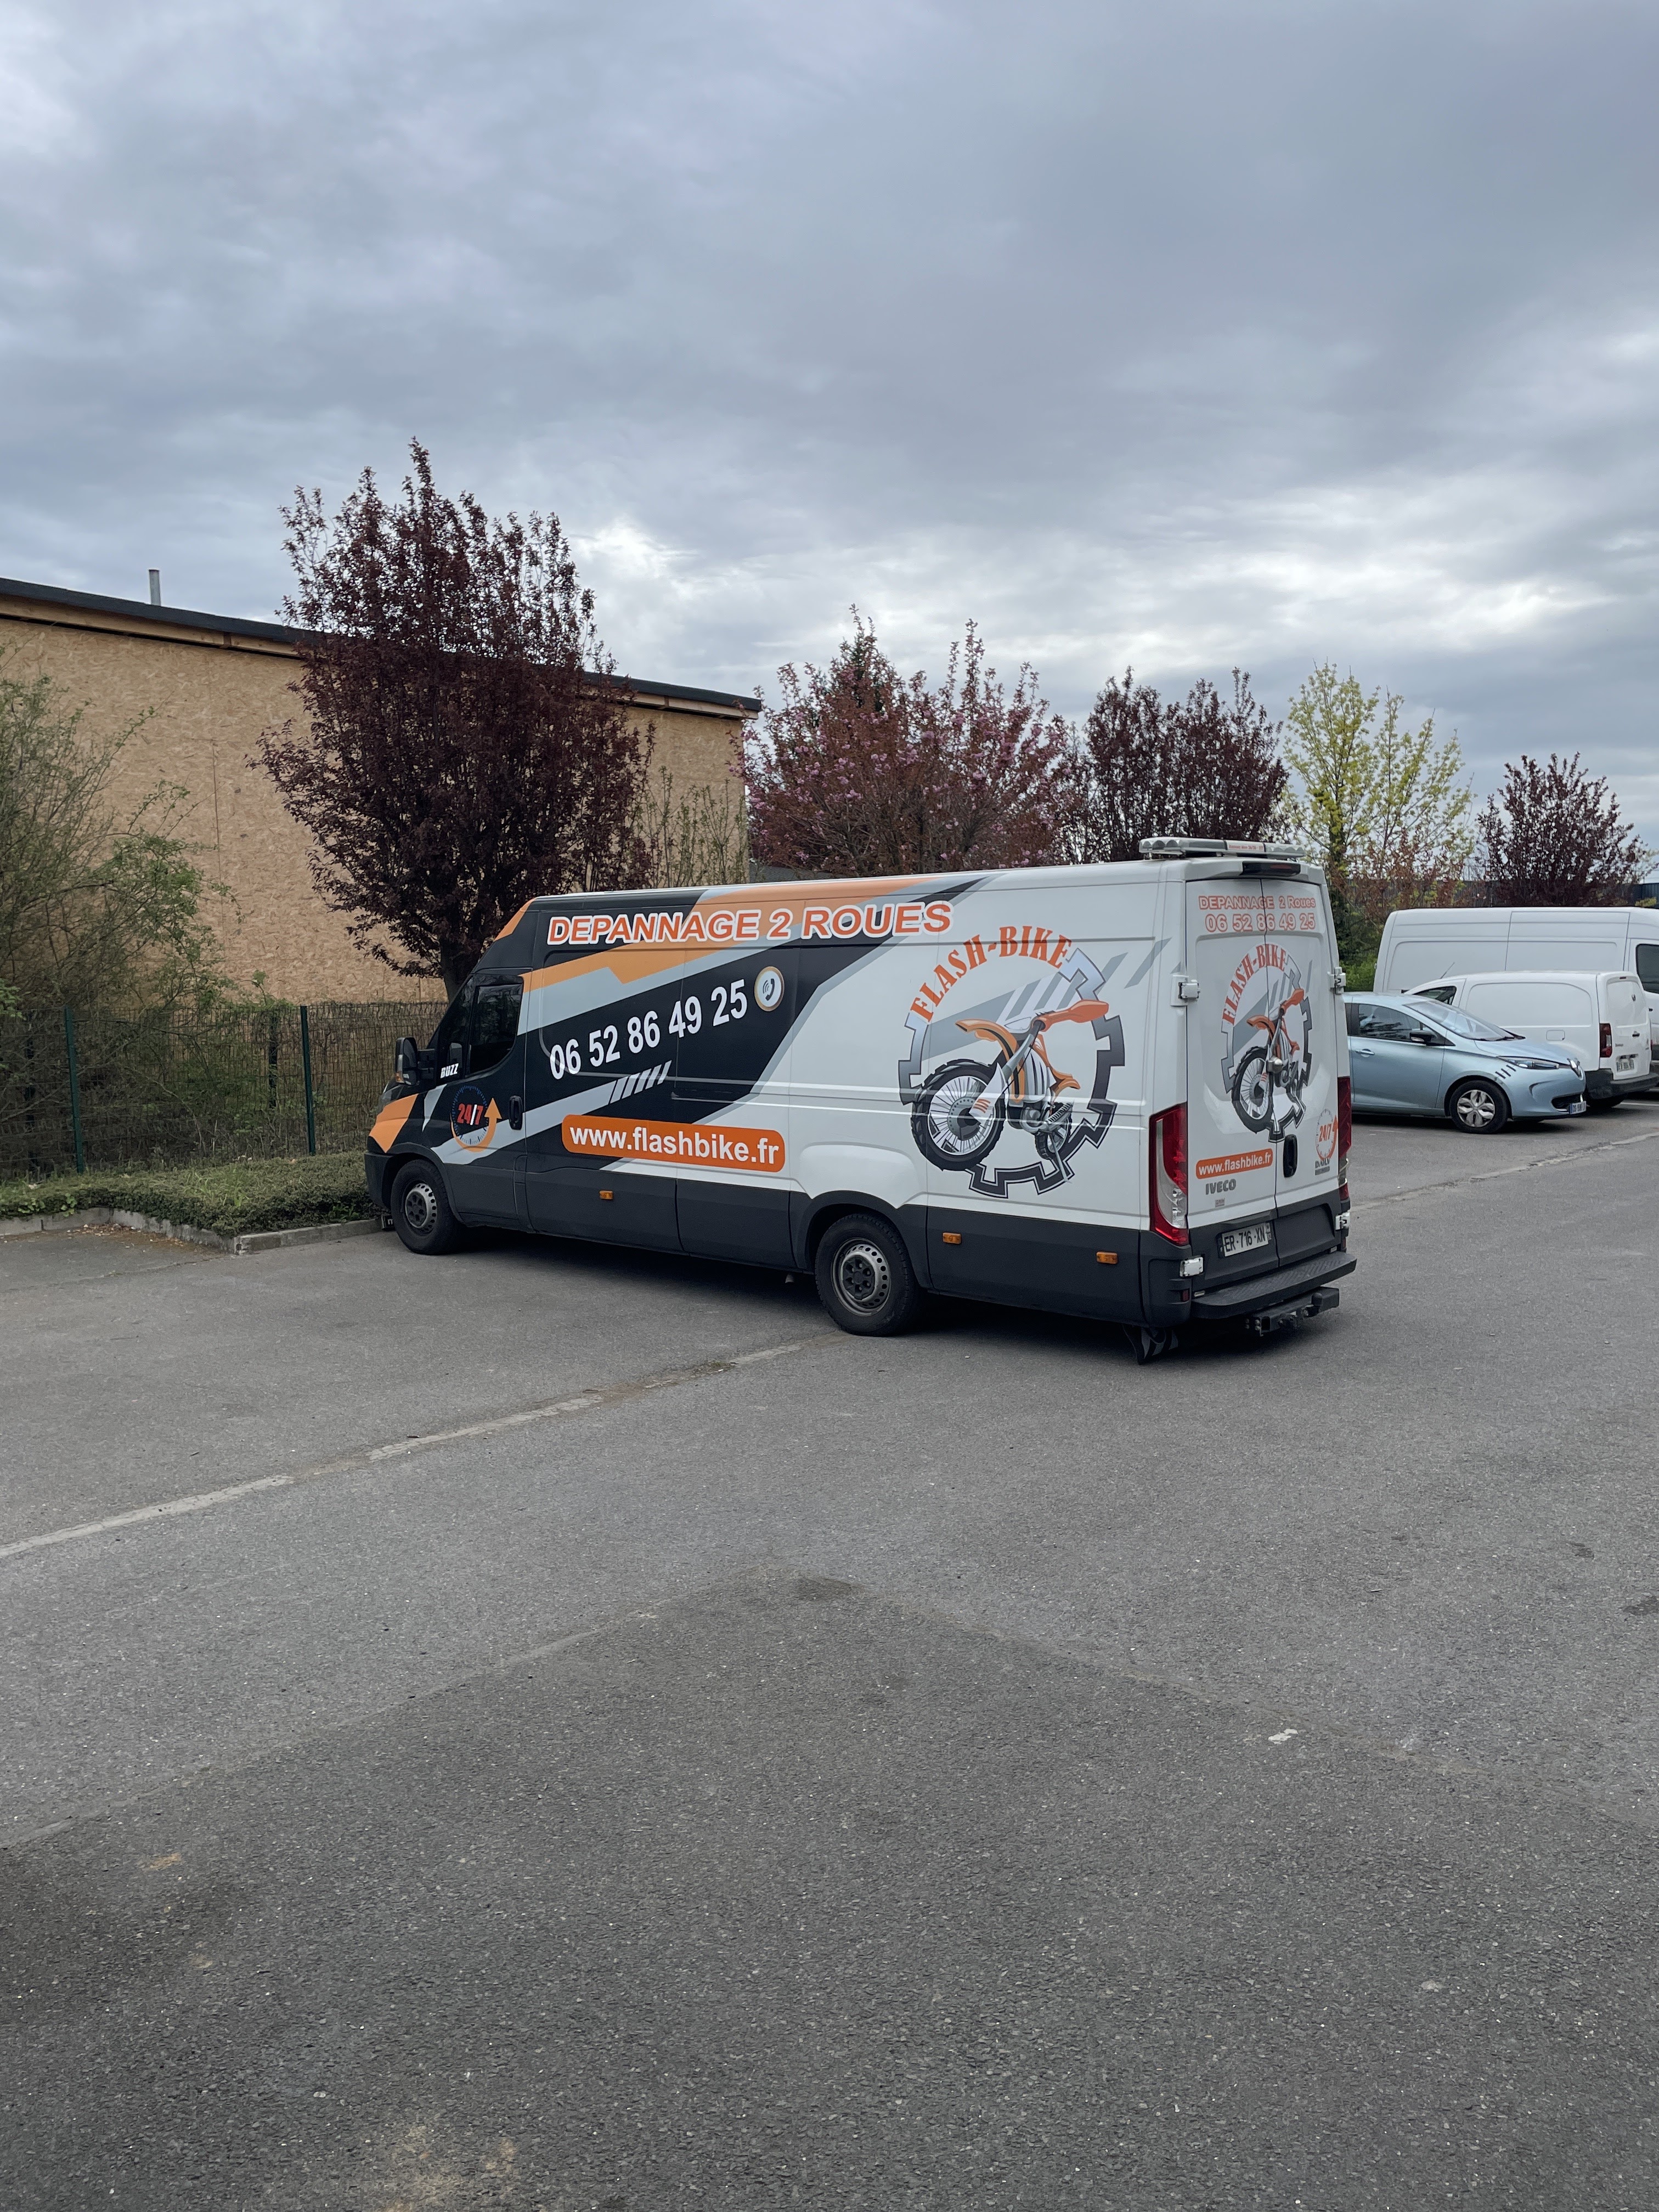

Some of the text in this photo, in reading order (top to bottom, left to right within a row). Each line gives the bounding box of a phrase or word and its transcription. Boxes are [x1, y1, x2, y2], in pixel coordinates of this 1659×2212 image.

[1199, 895, 1316, 910] DEPANNAGE 2 Roues
[547, 901, 954, 945] DEPANNAGE 2 ROUES
[1205, 912, 1316, 932] 06 52 86 49 25
[910, 926, 1073, 1023] FLASH-BIKE
[1222, 944, 1286, 1026] FLASH-BIKE
[550, 979, 747, 1080] 06 52 86 49 25
[441, 1063, 459, 1079] BUZZ
[457, 1103, 484, 1125] 24/7
[1319, 1124, 1332, 1142] 24/7
[569, 1126, 779, 1165] www.flashbike.fr
[1199, 1152, 1271, 1176] www.flashbike.fr
[1206, 1179, 1237, 1195] IVECO
